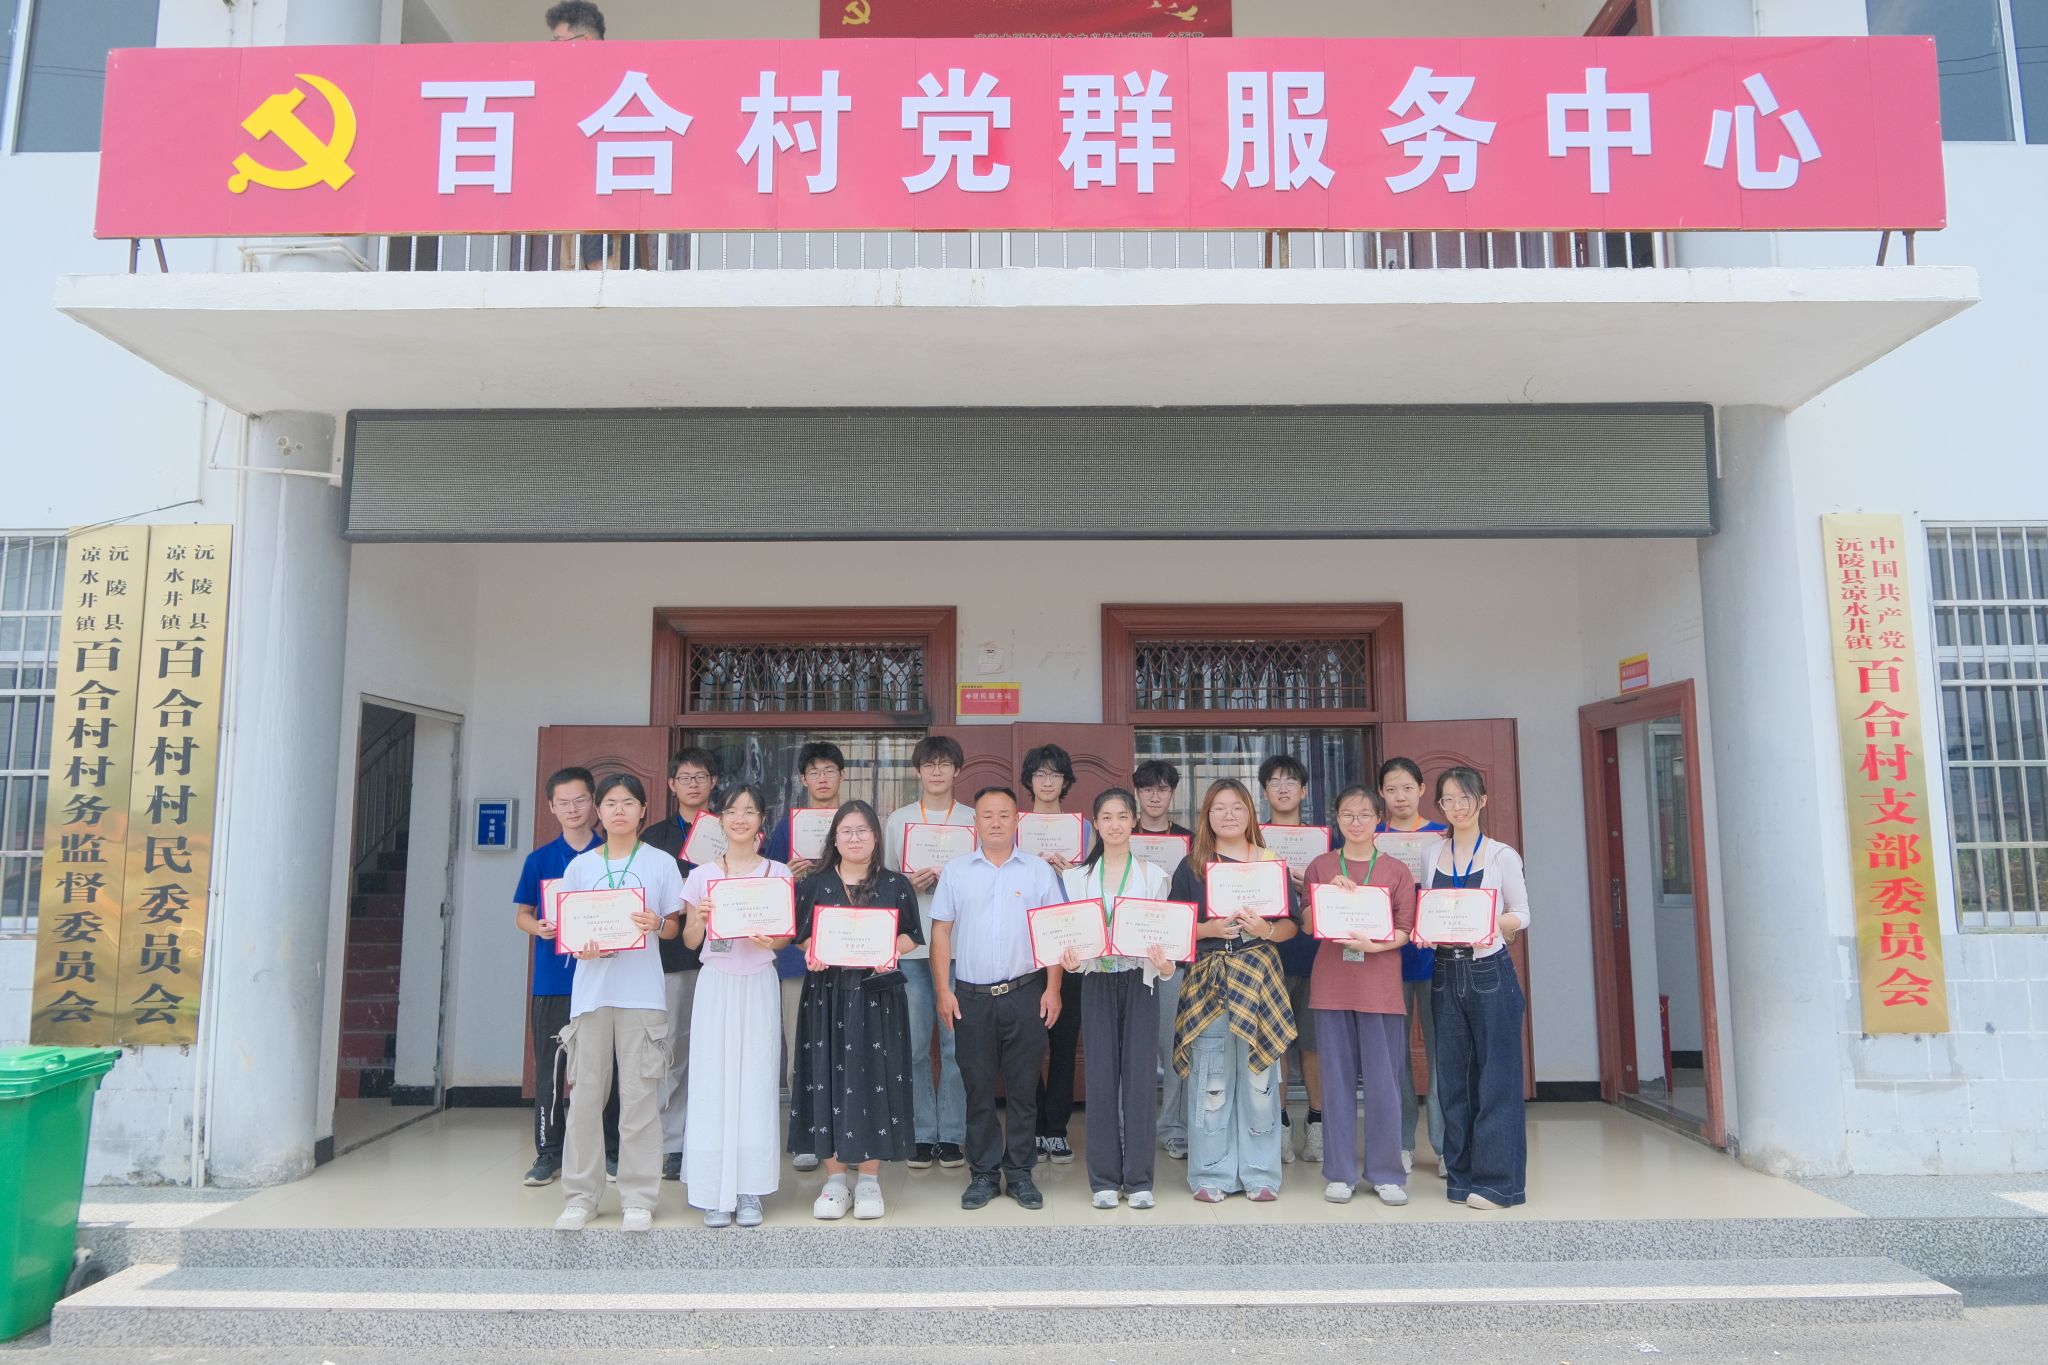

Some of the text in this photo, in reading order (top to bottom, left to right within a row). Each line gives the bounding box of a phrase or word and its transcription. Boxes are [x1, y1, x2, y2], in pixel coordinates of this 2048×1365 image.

[420, 66, 1822, 195] 百合村党群服务中心
[76, 547, 102, 631] 凉水井镇
[103, 545, 130, 631] 沅陵县
[160, 545, 187, 630] 凉水井镇
[187, 544, 215, 630] 沅陵县
[1836, 537, 1872, 650] 沅陵县凉水井镇
[1870, 536, 1906, 649] 中国共产党
[46, 637, 123, 1024] 百合村村务监督委员会
[131, 636, 207, 1025] 百合村村民委员会
[1848, 656, 1934, 1007] 百合村支部委员会
